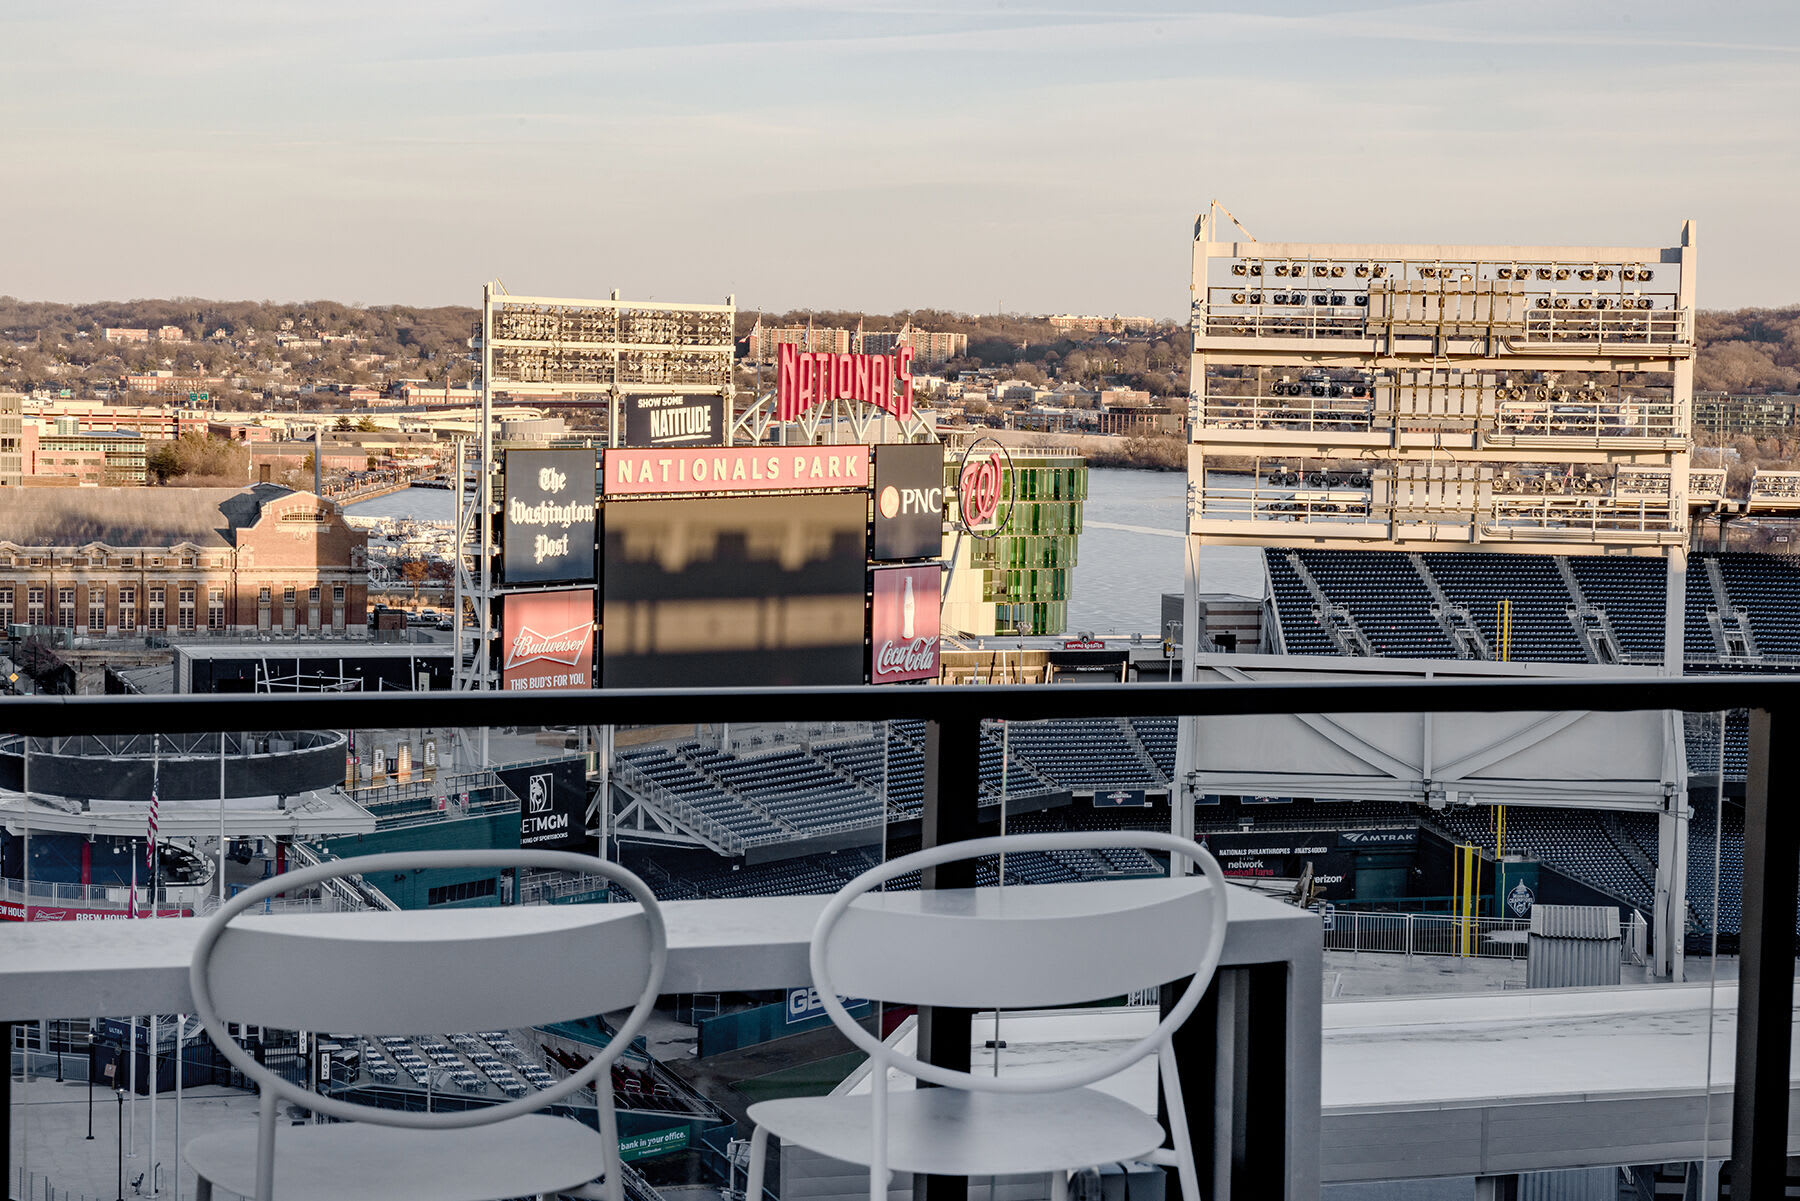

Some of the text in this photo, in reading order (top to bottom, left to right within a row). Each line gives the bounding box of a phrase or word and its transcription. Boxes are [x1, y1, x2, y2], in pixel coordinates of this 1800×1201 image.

[777, 343, 914, 421] NATIONALS
[637, 396, 684, 408] SHOW SOME
[650, 405, 712, 438] NATITUDE
[617, 455, 859, 484] NATIONALS PARK
[538, 467, 567, 494] The
[900, 487, 942, 515] PNC
[508, 496, 595, 529] Washington
[533, 533, 569, 565] Post
[513, 635, 585, 658] Budweiser
[877, 635, 939, 676] Coca-Cola
[510, 672, 586, 690] THIS BUD'S FOR YOU.
[522, 813, 568, 833] ETMGM
[1361, 834, 1413, 842] AMTRAK
[1247, 847, 1291, 855] PHILANTHROPIES
[1228, 860, 1264, 869] network
[1254, 868, 1274, 876] fans
[109, 1027, 123, 1035] ULTRA
[620, 1140, 639, 1150] bank
[639, 1139, 647, 1147] in
[647, 1136, 664, 1147] your
[664, 1131, 686, 1142] office.
